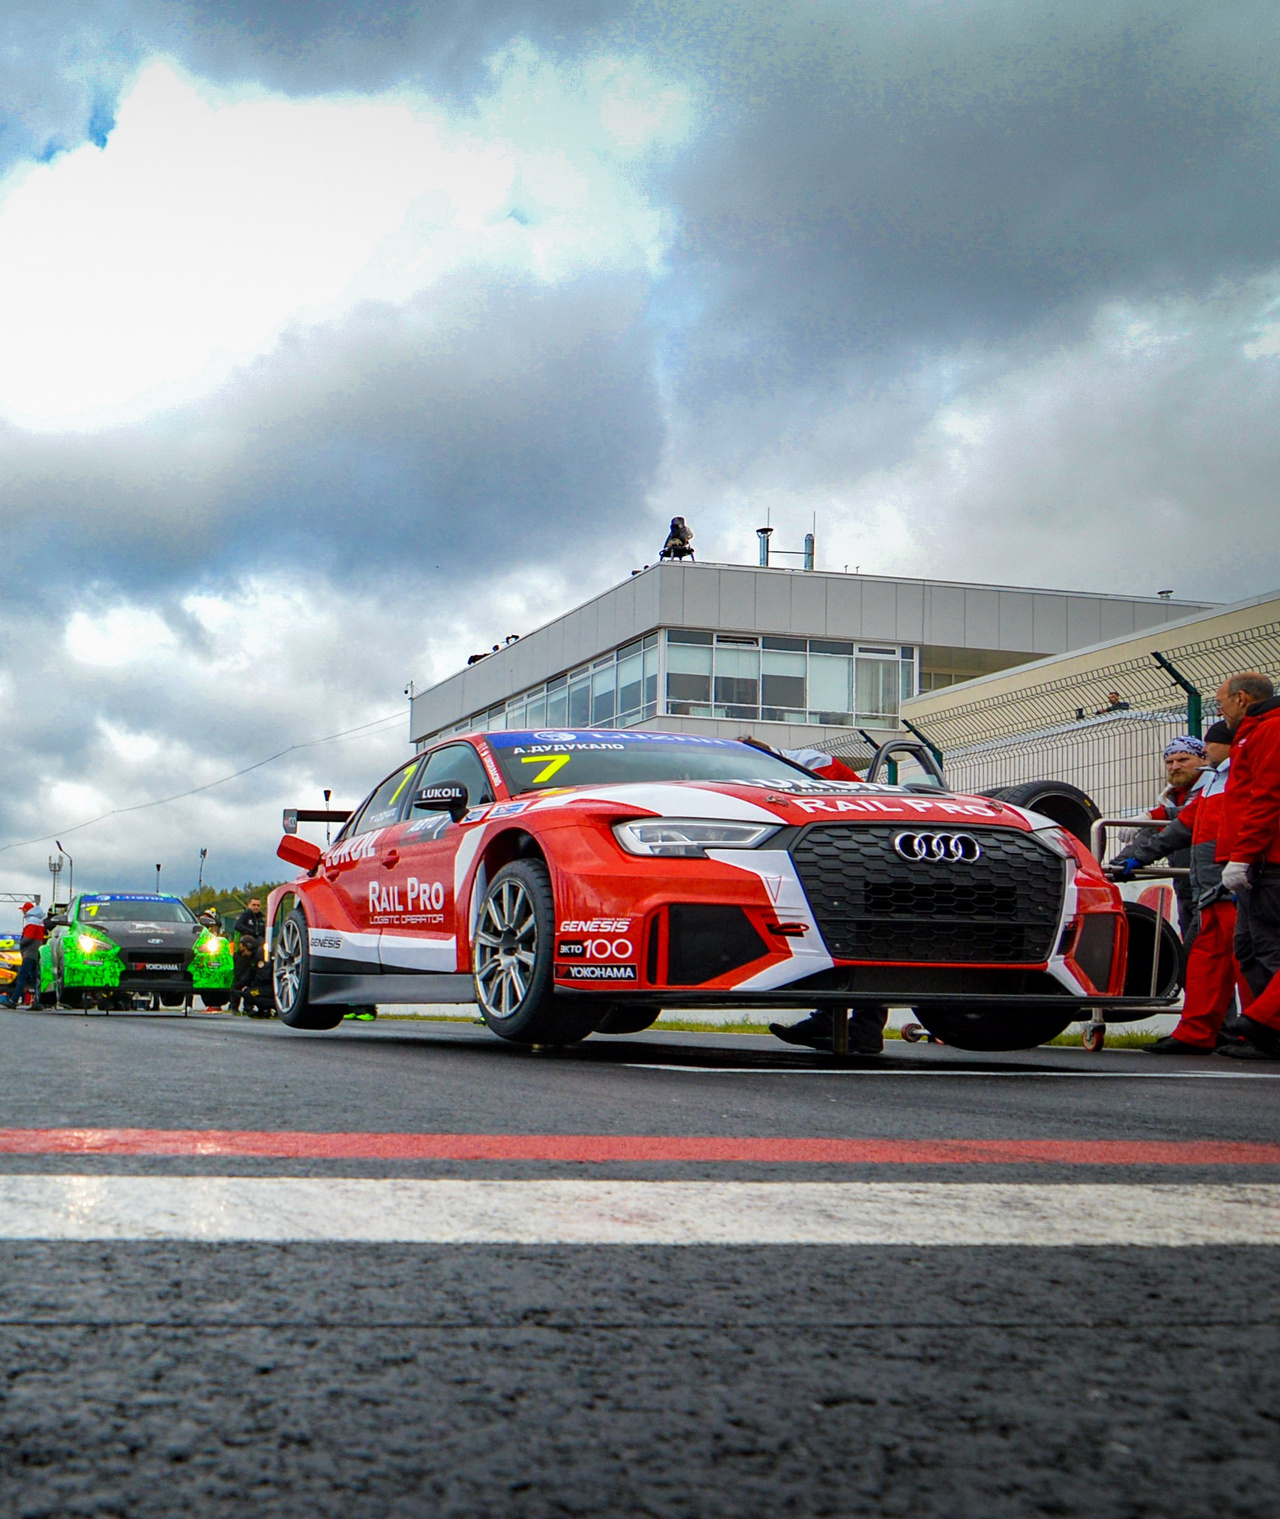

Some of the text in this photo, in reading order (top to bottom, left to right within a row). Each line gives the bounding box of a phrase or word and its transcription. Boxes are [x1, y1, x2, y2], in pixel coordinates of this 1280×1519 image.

[513, 743, 625, 755] А.ДУДУКАЛО
[521, 754, 571, 783] 7
[730, 778, 905, 792] LUKOIL
[422, 787, 463, 799] LUKOIL
[791, 799, 996, 817] RAIL PRO
[324, 828, 386, 867] LUKOIL
[369, 877, 444, 912] RAIL PRO
[401, 914, 444, 924] OPERATOR
[560, 921, 630, 932] GENESIS
[310, 938, 342, 949] GENESIS
[583, 938, 633, 959] 100
[145, 963, 178, 971] YOKOHAMA
[569, 967, 635, 978] YOKOHAMA
